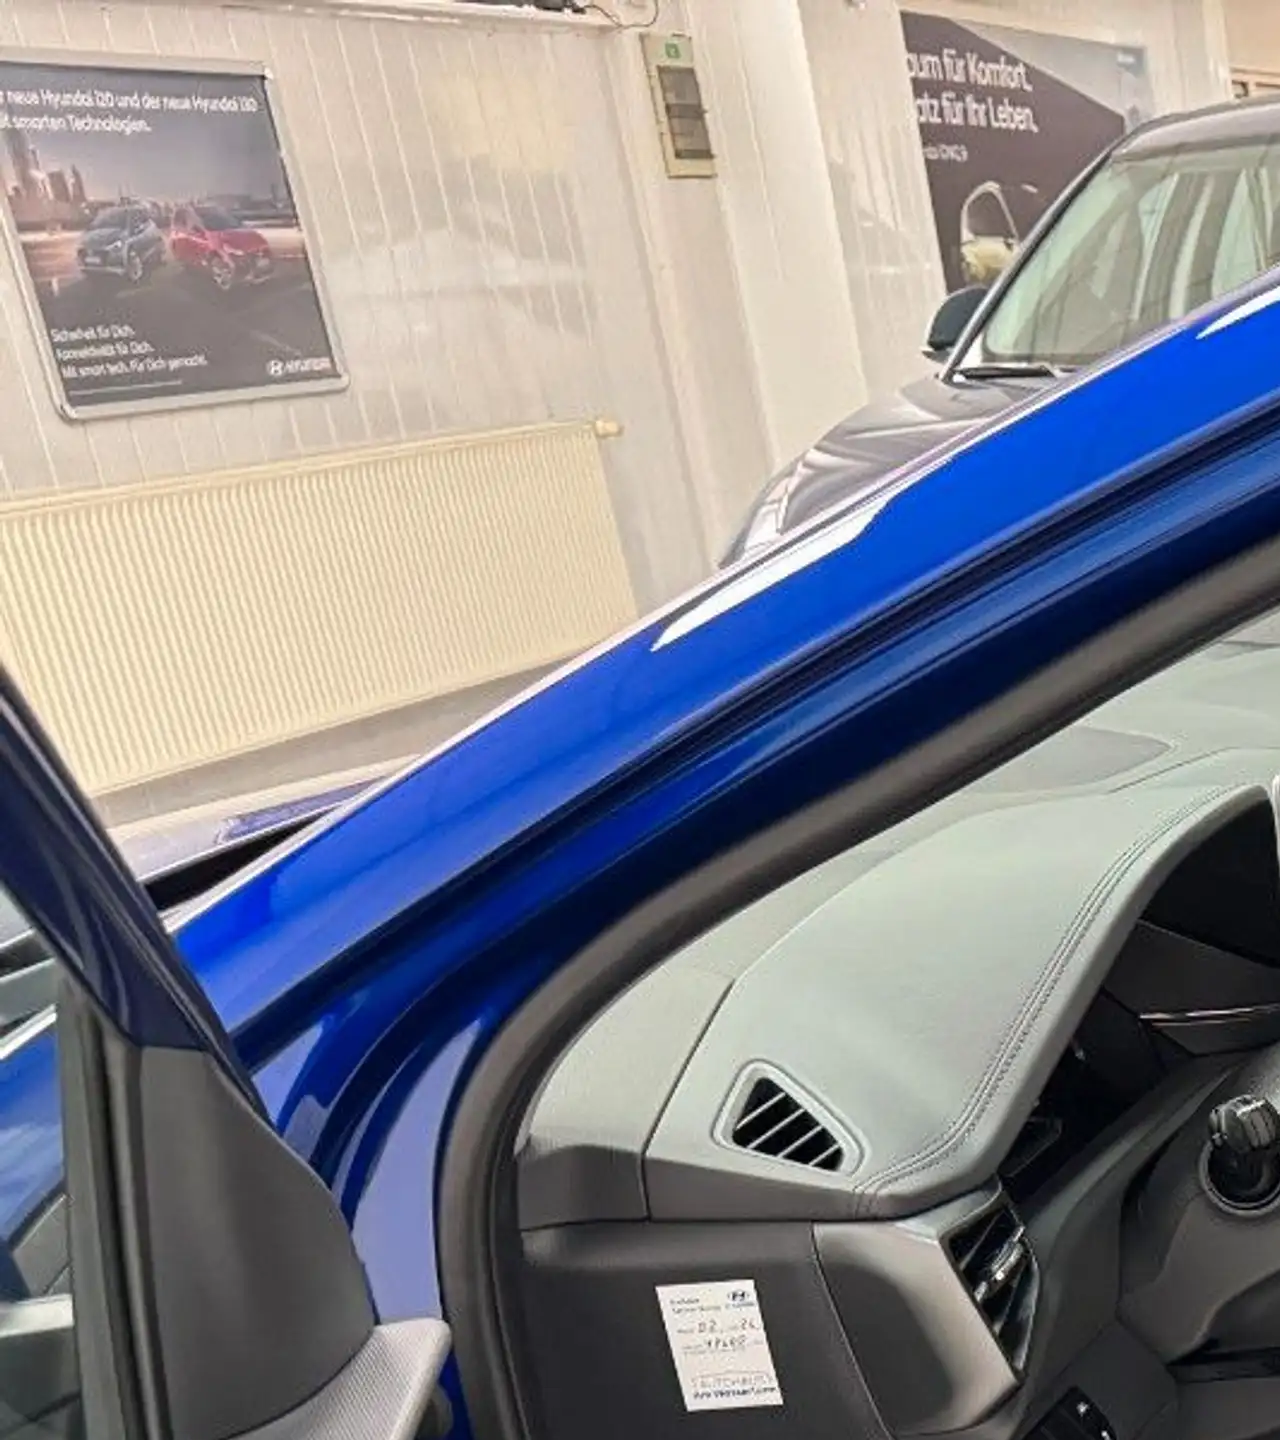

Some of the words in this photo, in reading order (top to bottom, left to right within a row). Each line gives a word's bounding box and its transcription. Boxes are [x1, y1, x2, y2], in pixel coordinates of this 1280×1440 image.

[943, 48, 965, 82] für
[40, 89, 94, 110] Hyundai
[116, 90, 139, 109] und
[192, 92, 238, 113] Hyundai
[942, 90, 964, 125] für
